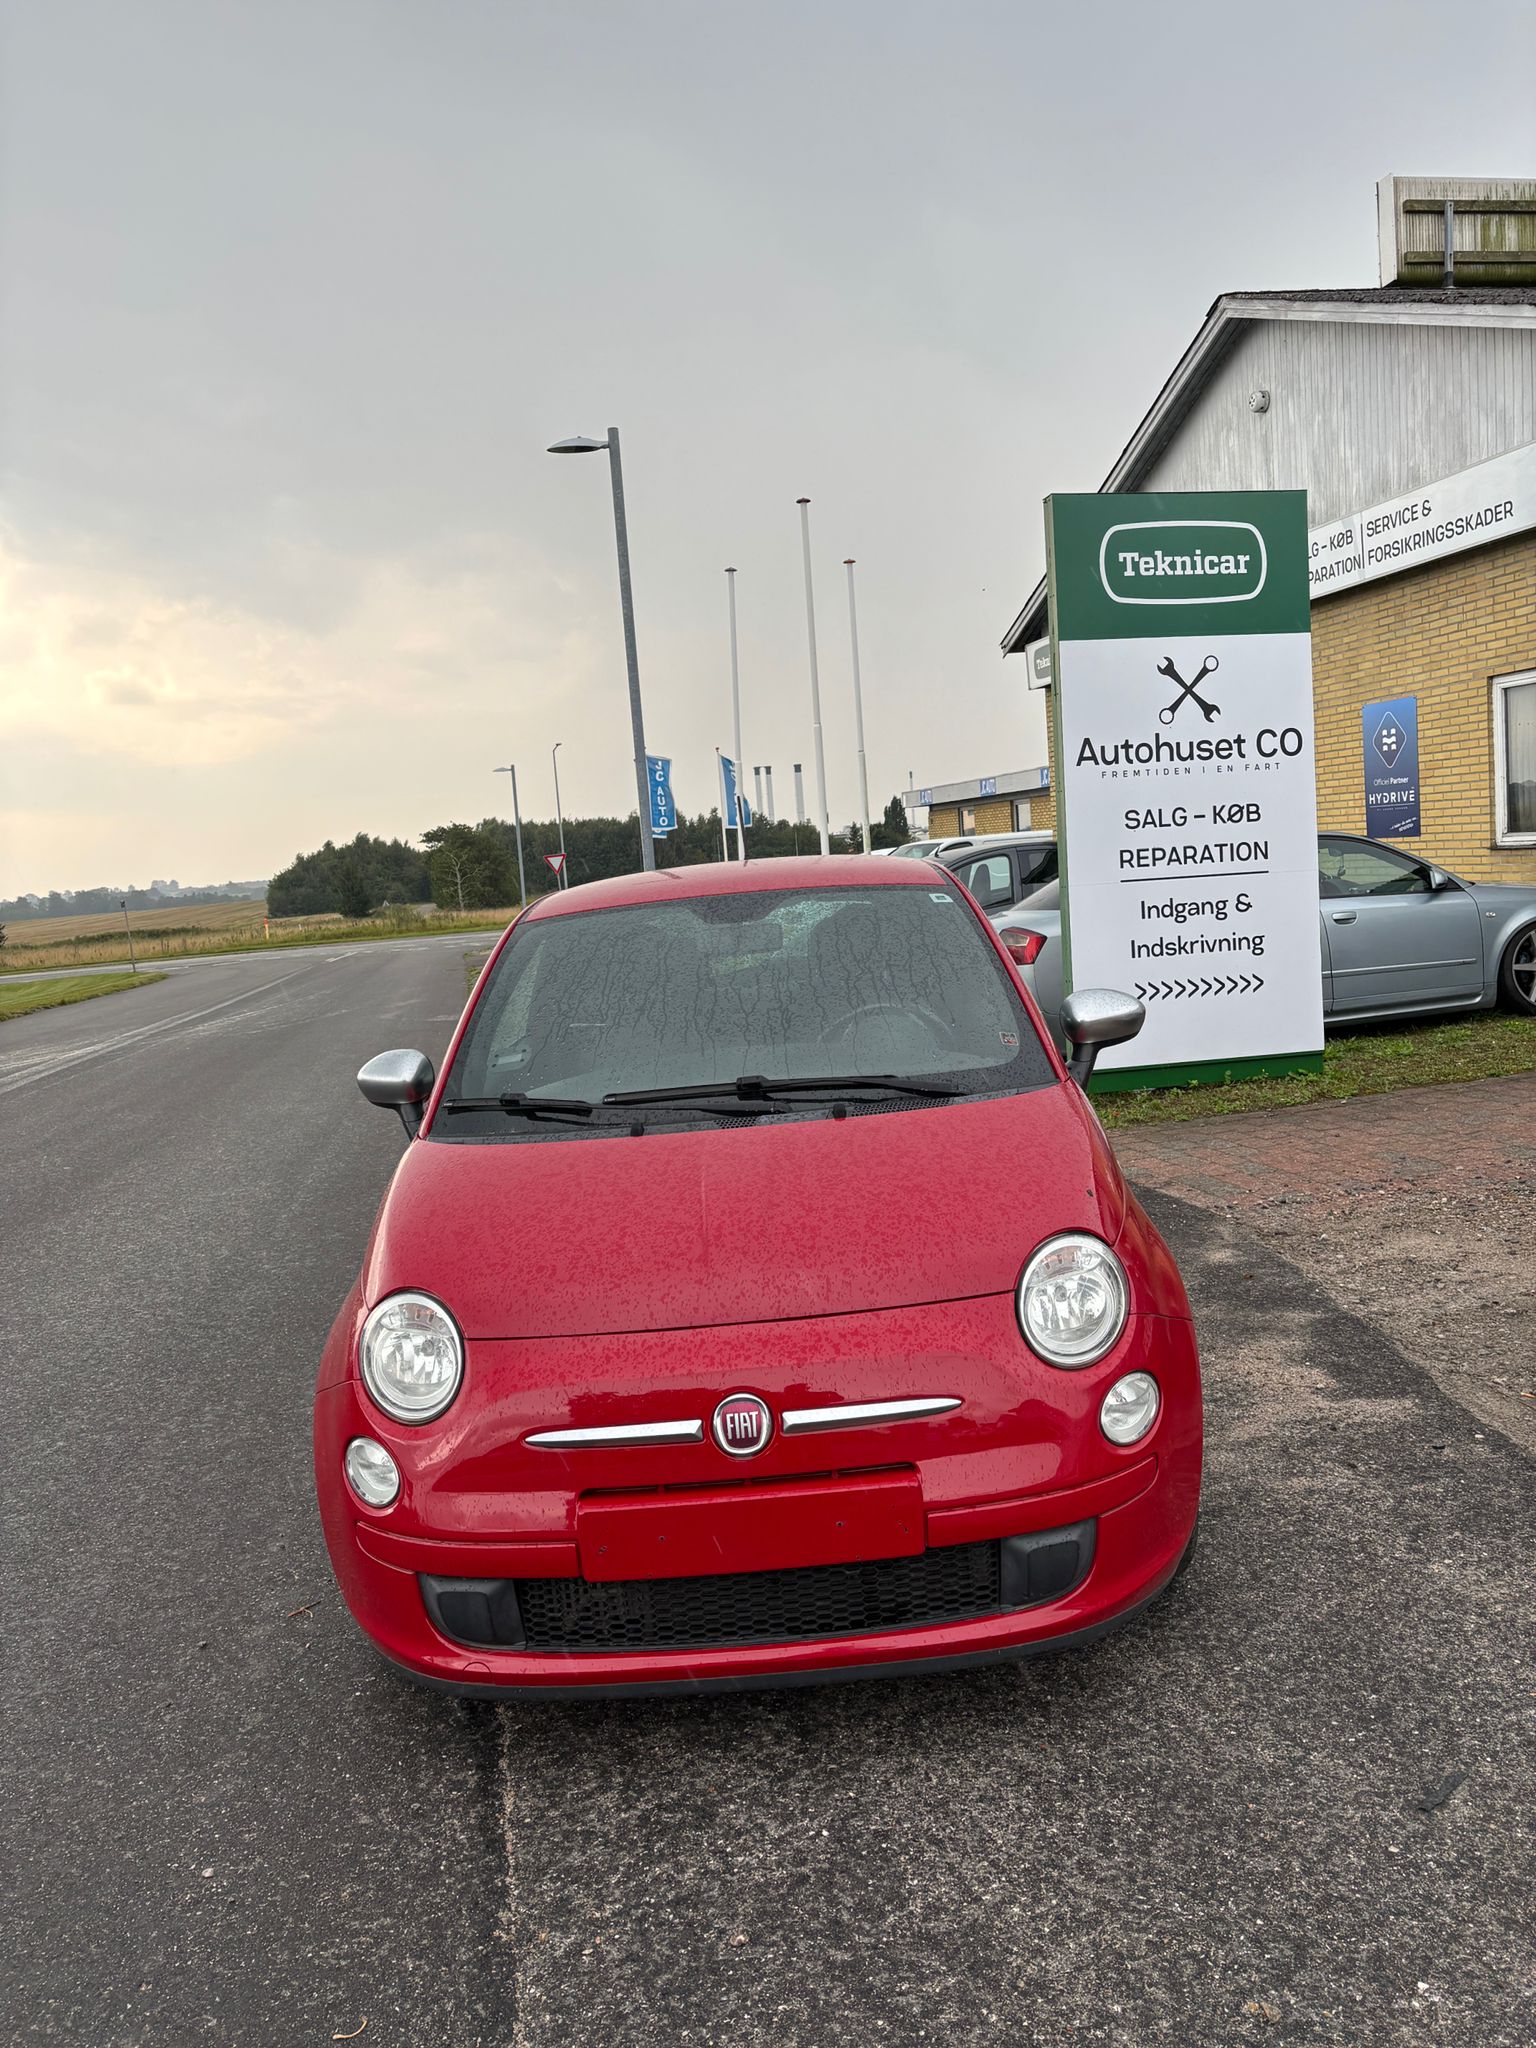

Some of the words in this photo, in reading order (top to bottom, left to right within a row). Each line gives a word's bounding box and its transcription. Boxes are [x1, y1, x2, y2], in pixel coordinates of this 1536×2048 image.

[1366, 503, 1419, 538] SERVICE
[1422, 499, 1432, 517] &
[1329, 529, 1354, 551] KØB
[1368, 500, 1514, 566] FORSIKRINGSSKADER
[1118, 549, 1250, 577] Teknicar
[1076, 733, 1246, 767] Autohuset
[1256, 728, 1303, 758] CO
[655, 761, 664, 781] JC
[1101, 767, 1191, 779] FREMTIDEN
[1202, 766, 1206, 774] I
[1217, 764, 1234, 773] EN
[1244, 762, 1281, 771] FART
[1389, 776, 1409, 785] Partner
[657, 786, 669, 827] AUTO
[1124, 806, 1188, 830] SALG
[1212, 803, 1262, 825] KØB
[1119, 841, 1269, 869] REPARATION
[1140, 897, 1229, 923] Indgang
[1235, 893, 1253, 912] &
[1130, 931, 1265, 959] Indskrivning
[726, 1411, 759, 1439] FIAT
